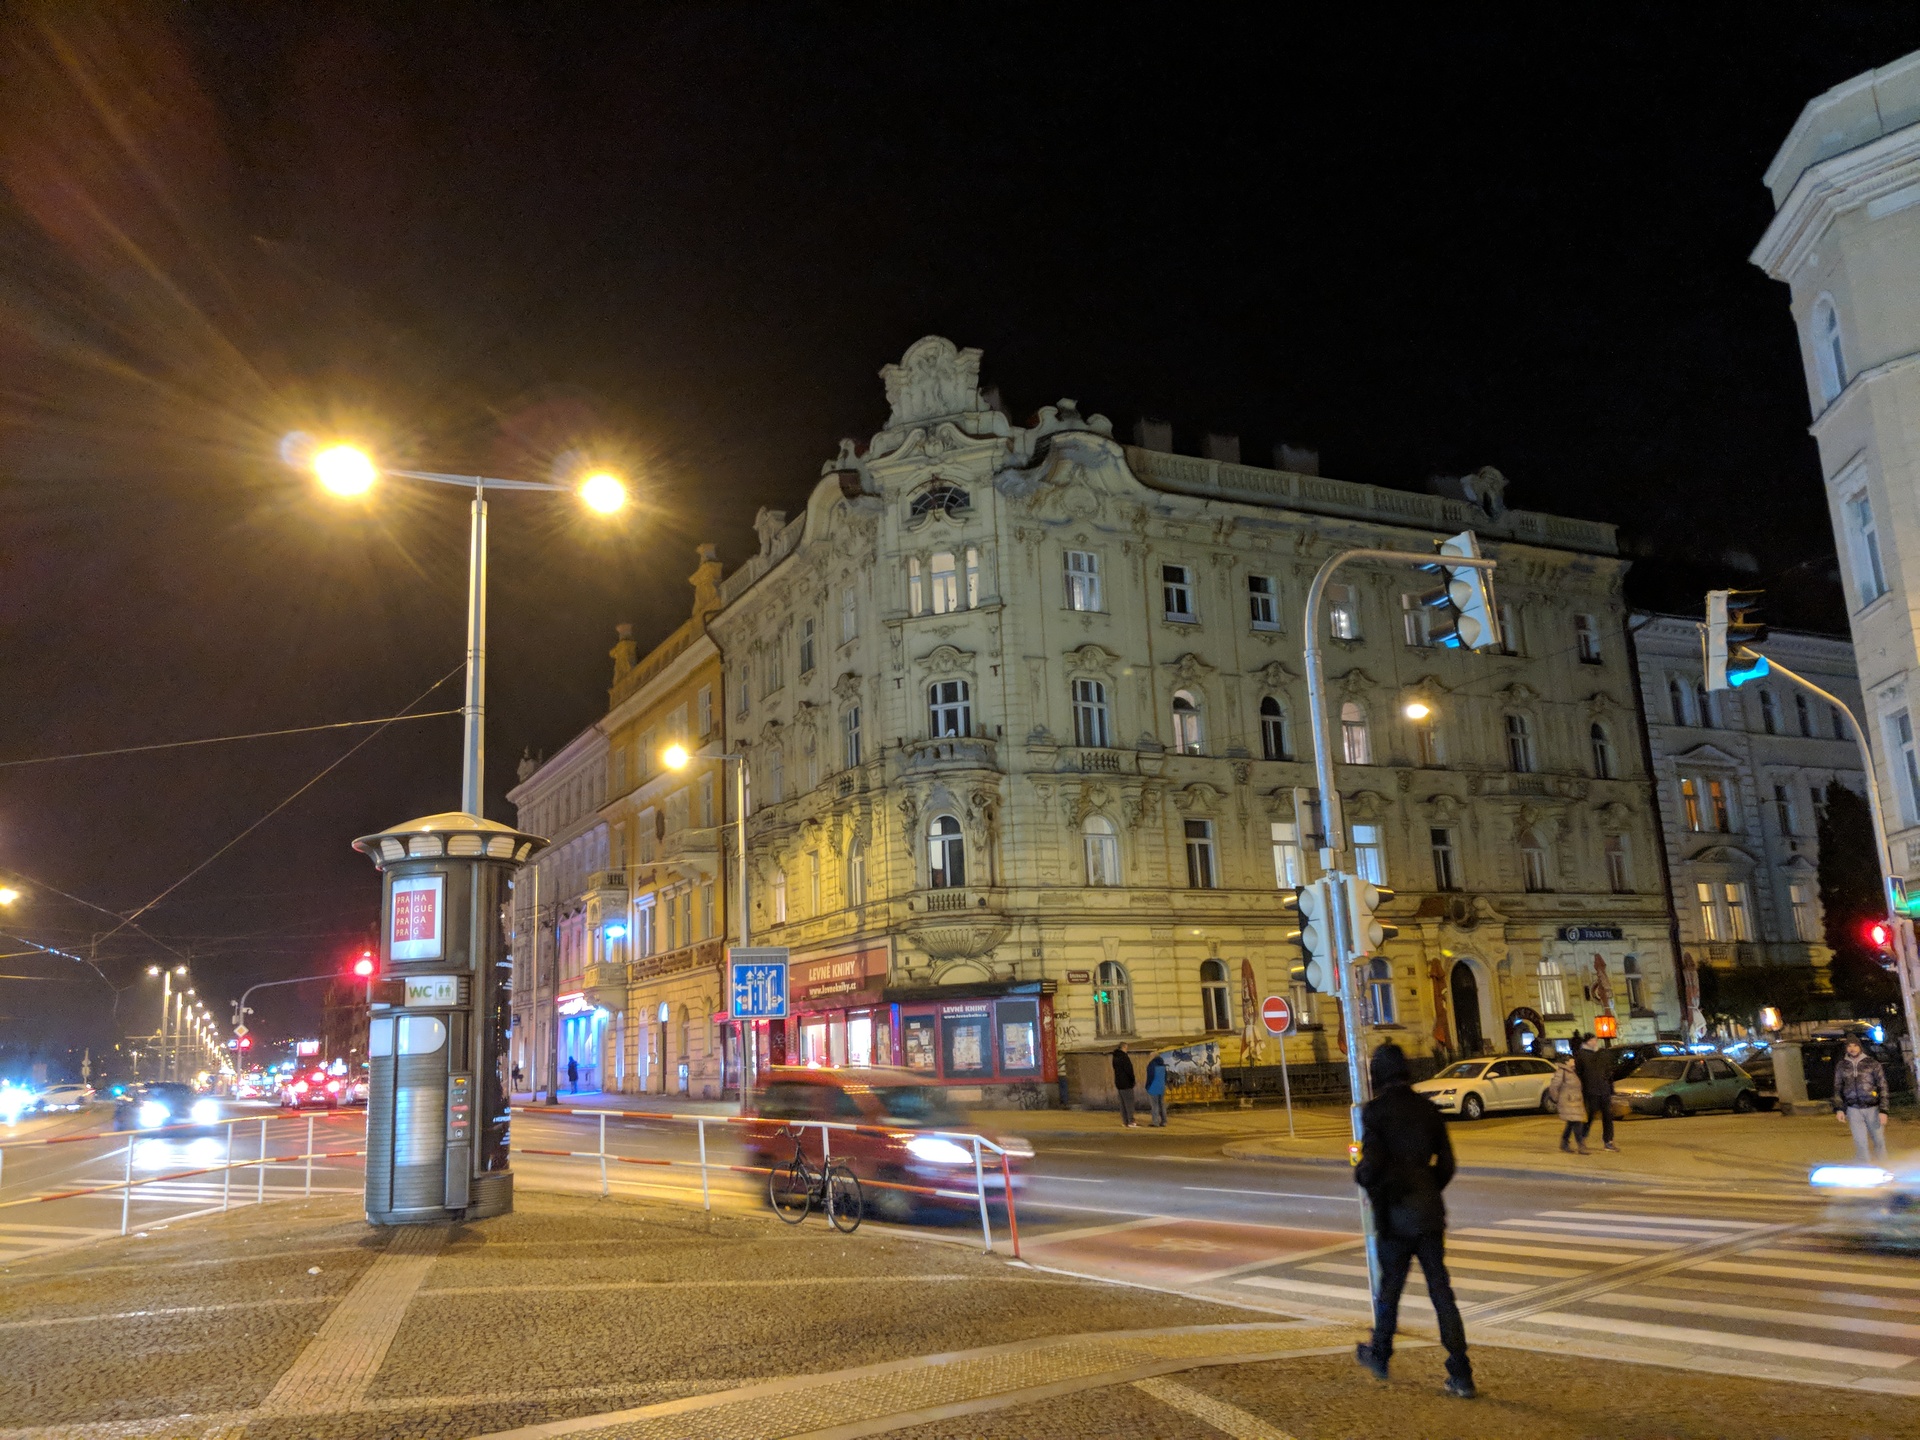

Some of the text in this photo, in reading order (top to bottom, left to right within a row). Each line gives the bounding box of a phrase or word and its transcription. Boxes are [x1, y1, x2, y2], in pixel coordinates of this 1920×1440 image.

[1585, 930, 1614, 938] FRAKTAL
[809, 960, 855, 981] LEVNÉ KNIHY
[409, 985, 432, 998] WC
[943, 1005, 964, 1013] LEVNÉ
